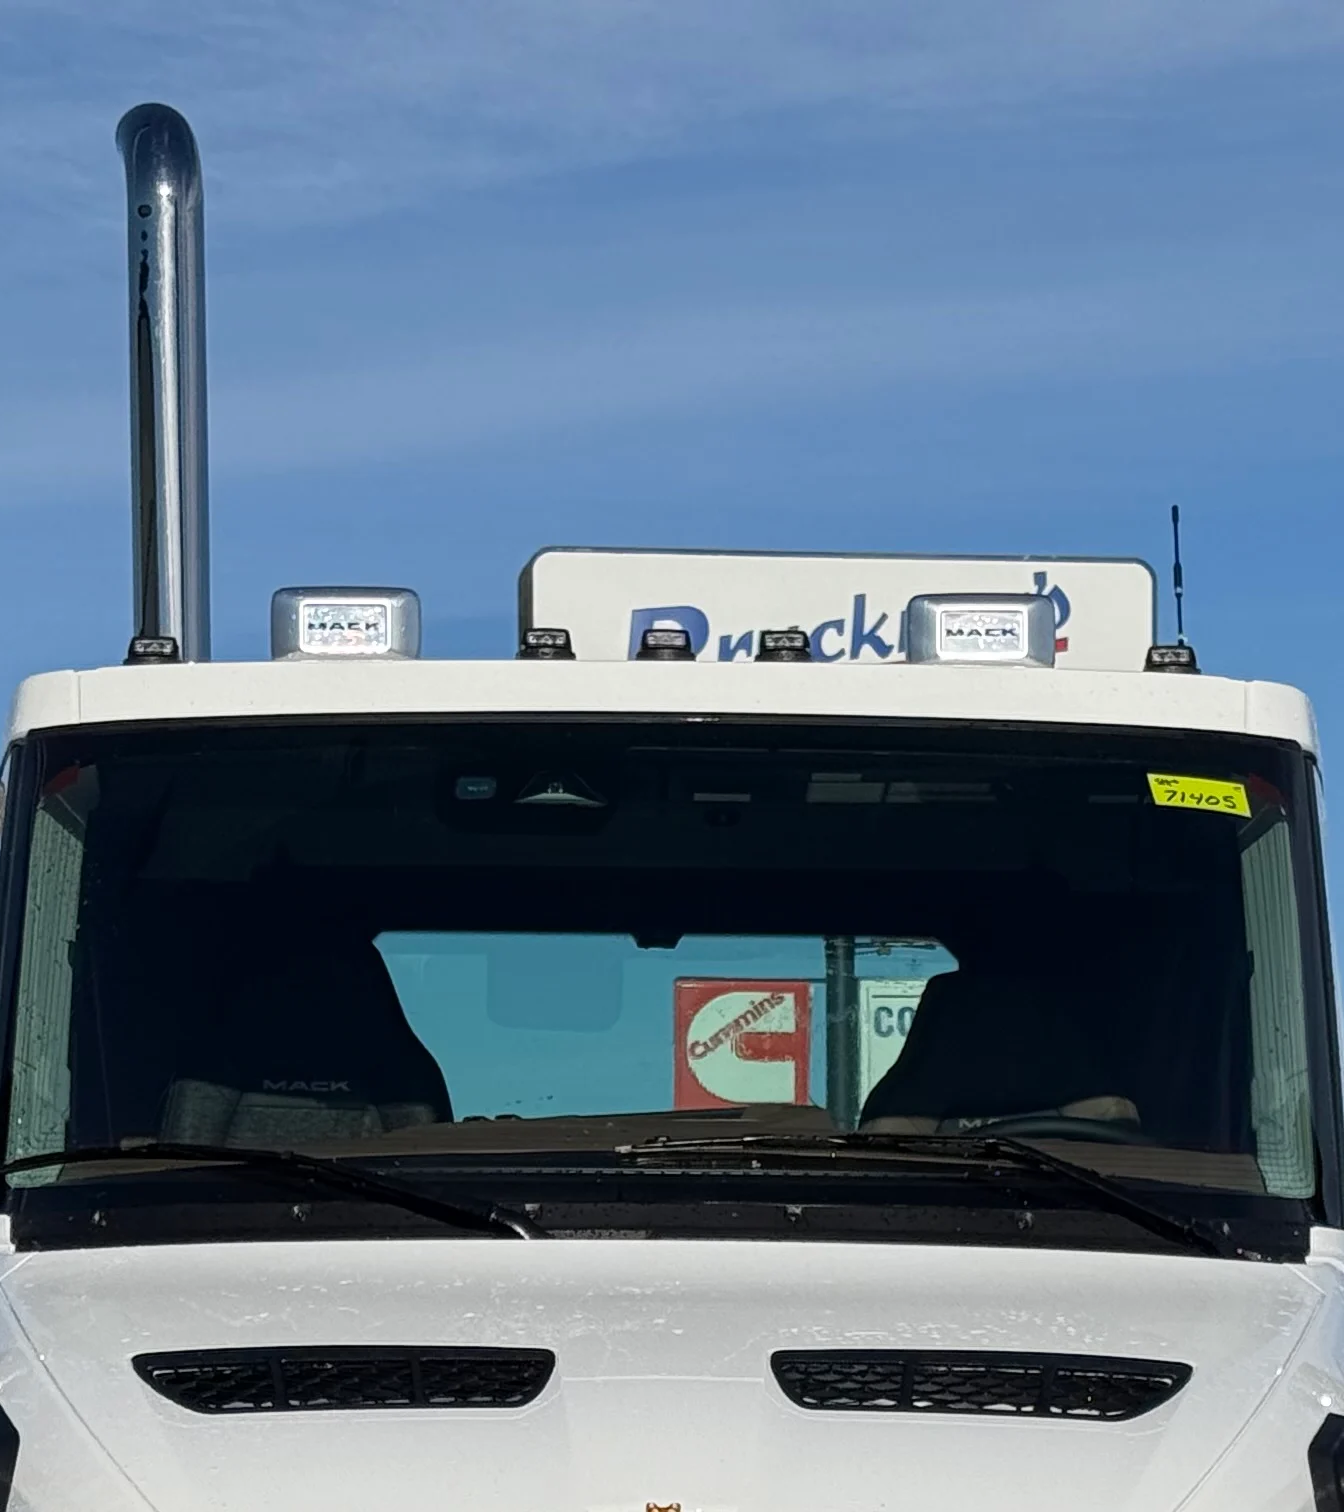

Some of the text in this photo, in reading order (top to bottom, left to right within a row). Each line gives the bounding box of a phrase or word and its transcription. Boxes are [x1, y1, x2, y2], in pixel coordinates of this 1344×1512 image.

[307, 621, 379, 632] MACK
[945, 628, 1017, 638] MACK
[1164, 789, 1237, 810] 71405
[689, 992, 785, 1060] Cummins
[262, 1079, 353, 1092] MACK
